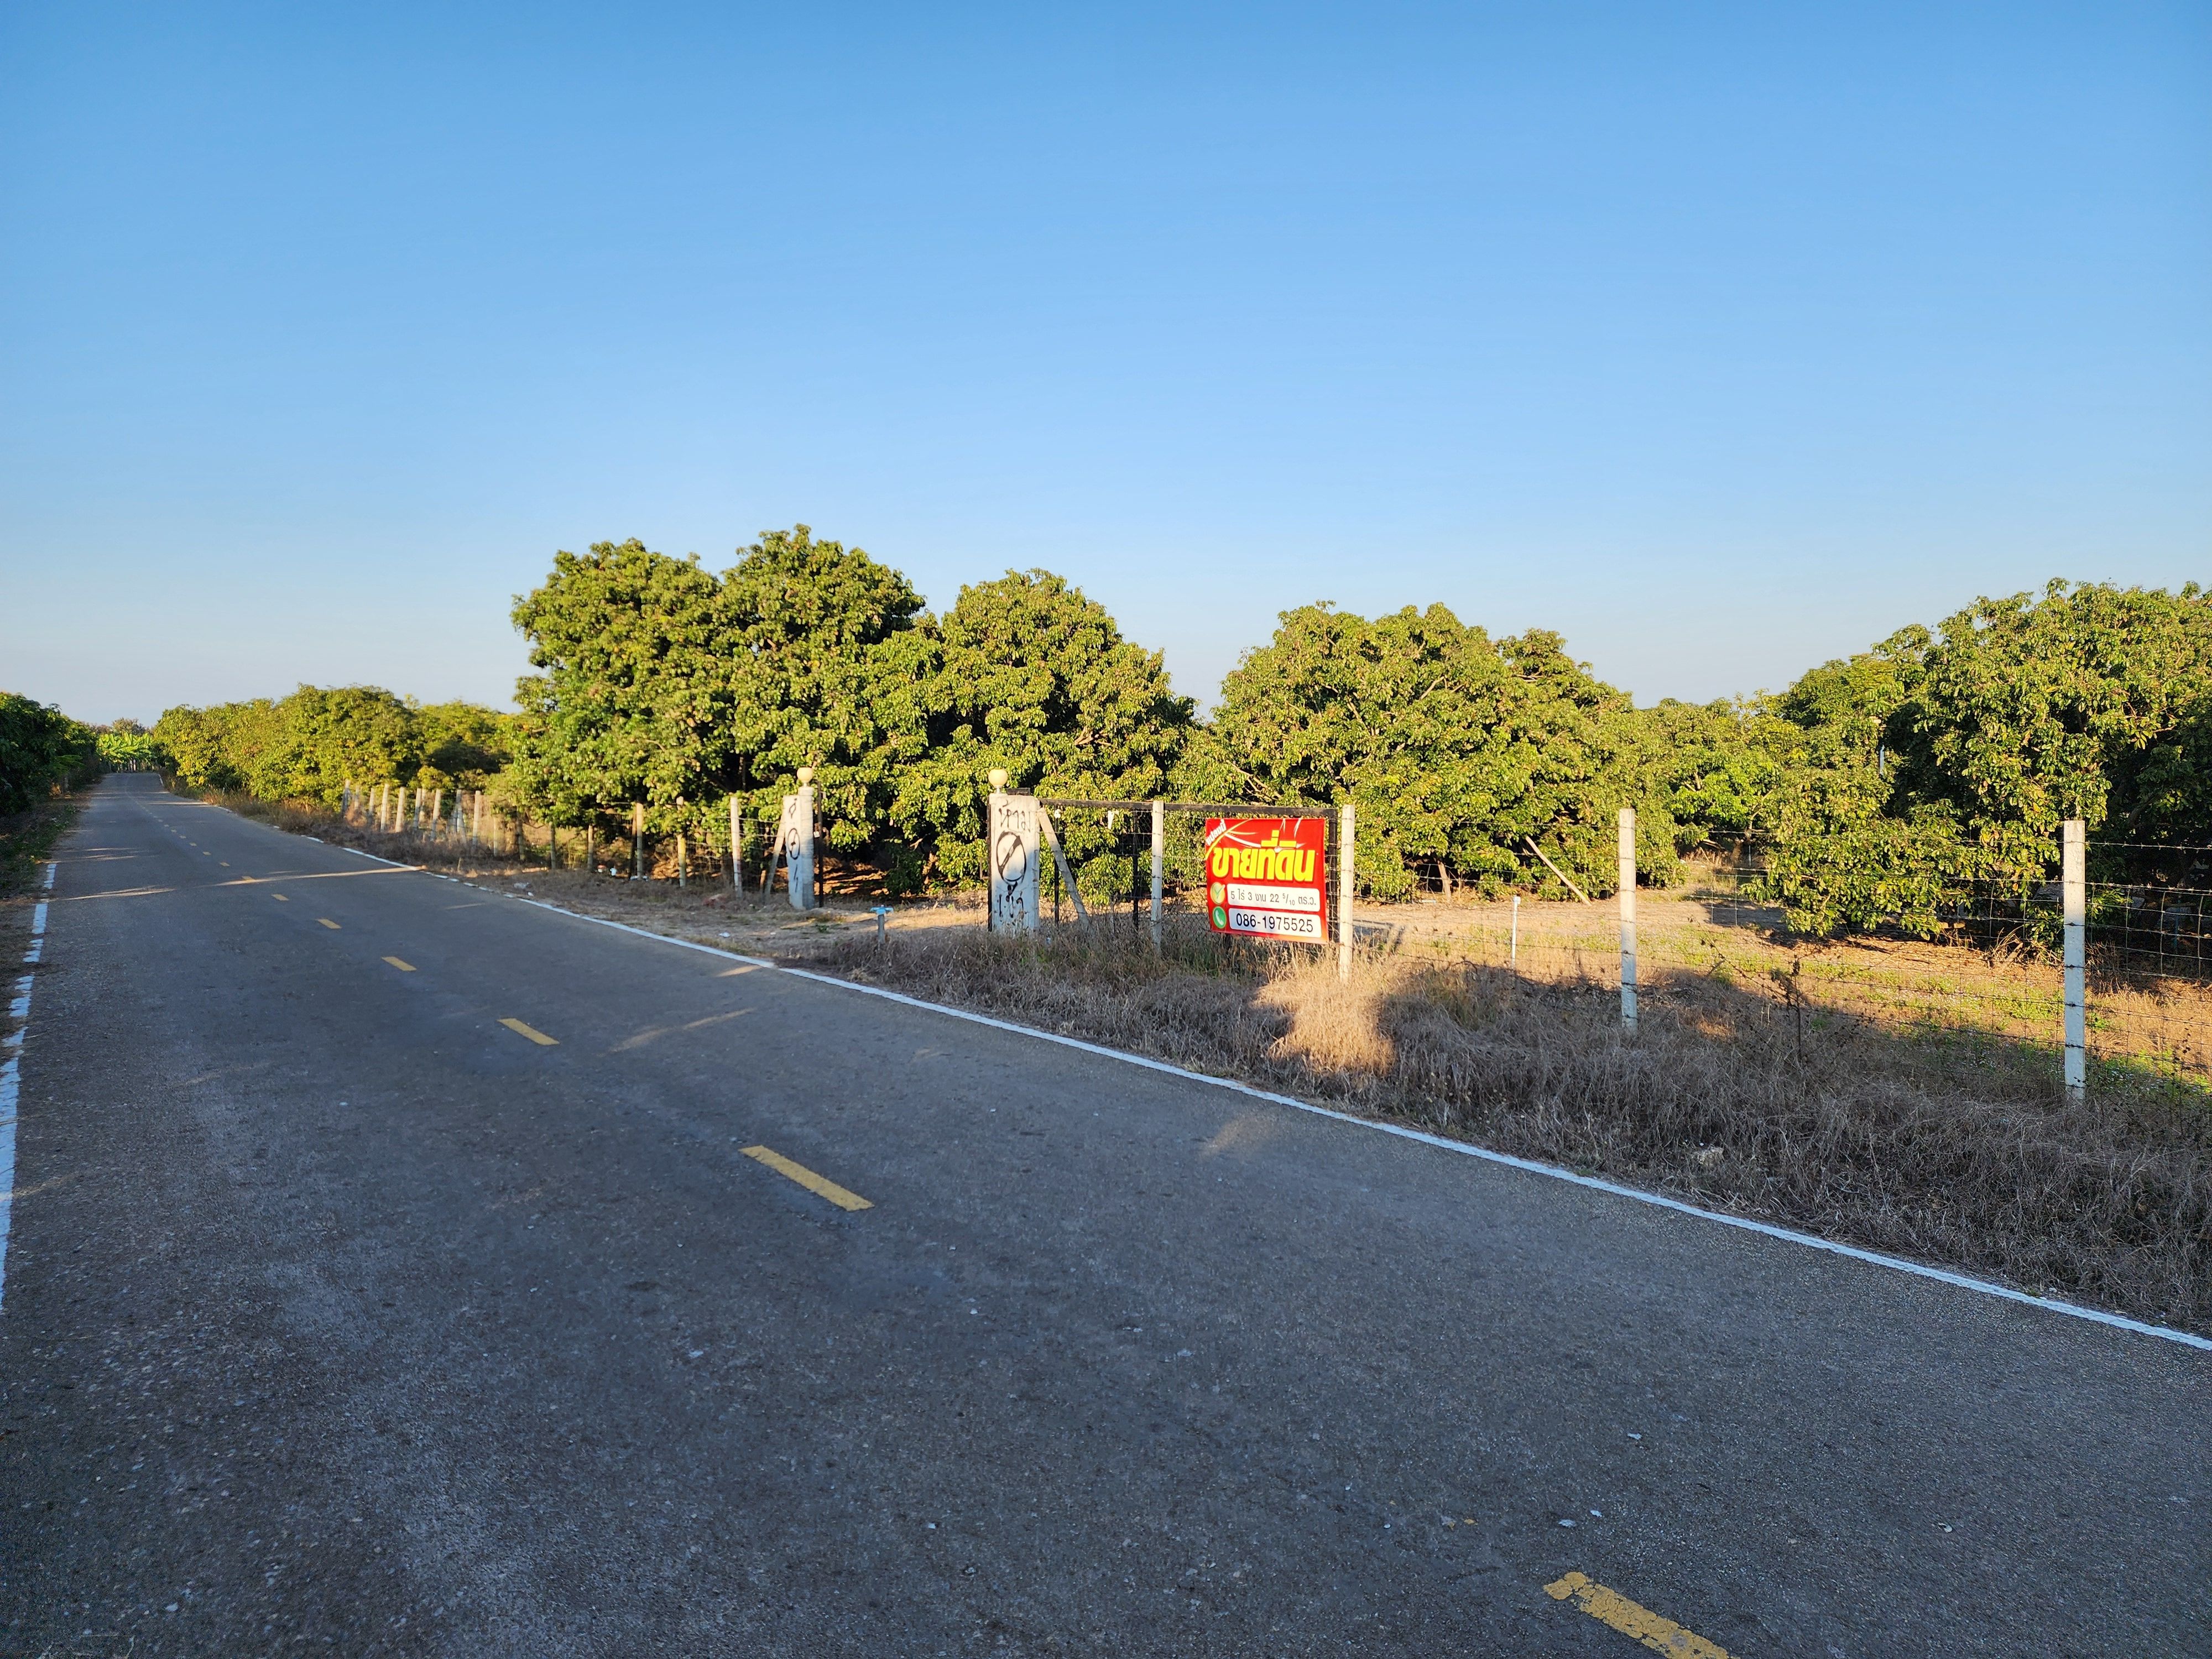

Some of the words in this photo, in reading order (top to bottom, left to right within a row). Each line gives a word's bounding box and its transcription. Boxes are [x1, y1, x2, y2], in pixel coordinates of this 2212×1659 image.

[1212, 830, 1316, 881] ขายที่ดิน
[1230, 891, 1235, 899] 5
[1248, 892, 1252, 900] 3
[1255, 893, 1266, 902] งาน
[1270, 894, 1280, 902] 22
[1298, 896, 1316, 905] ตร.ว.
[1236, 912, 1313, 933] 086-1975525
